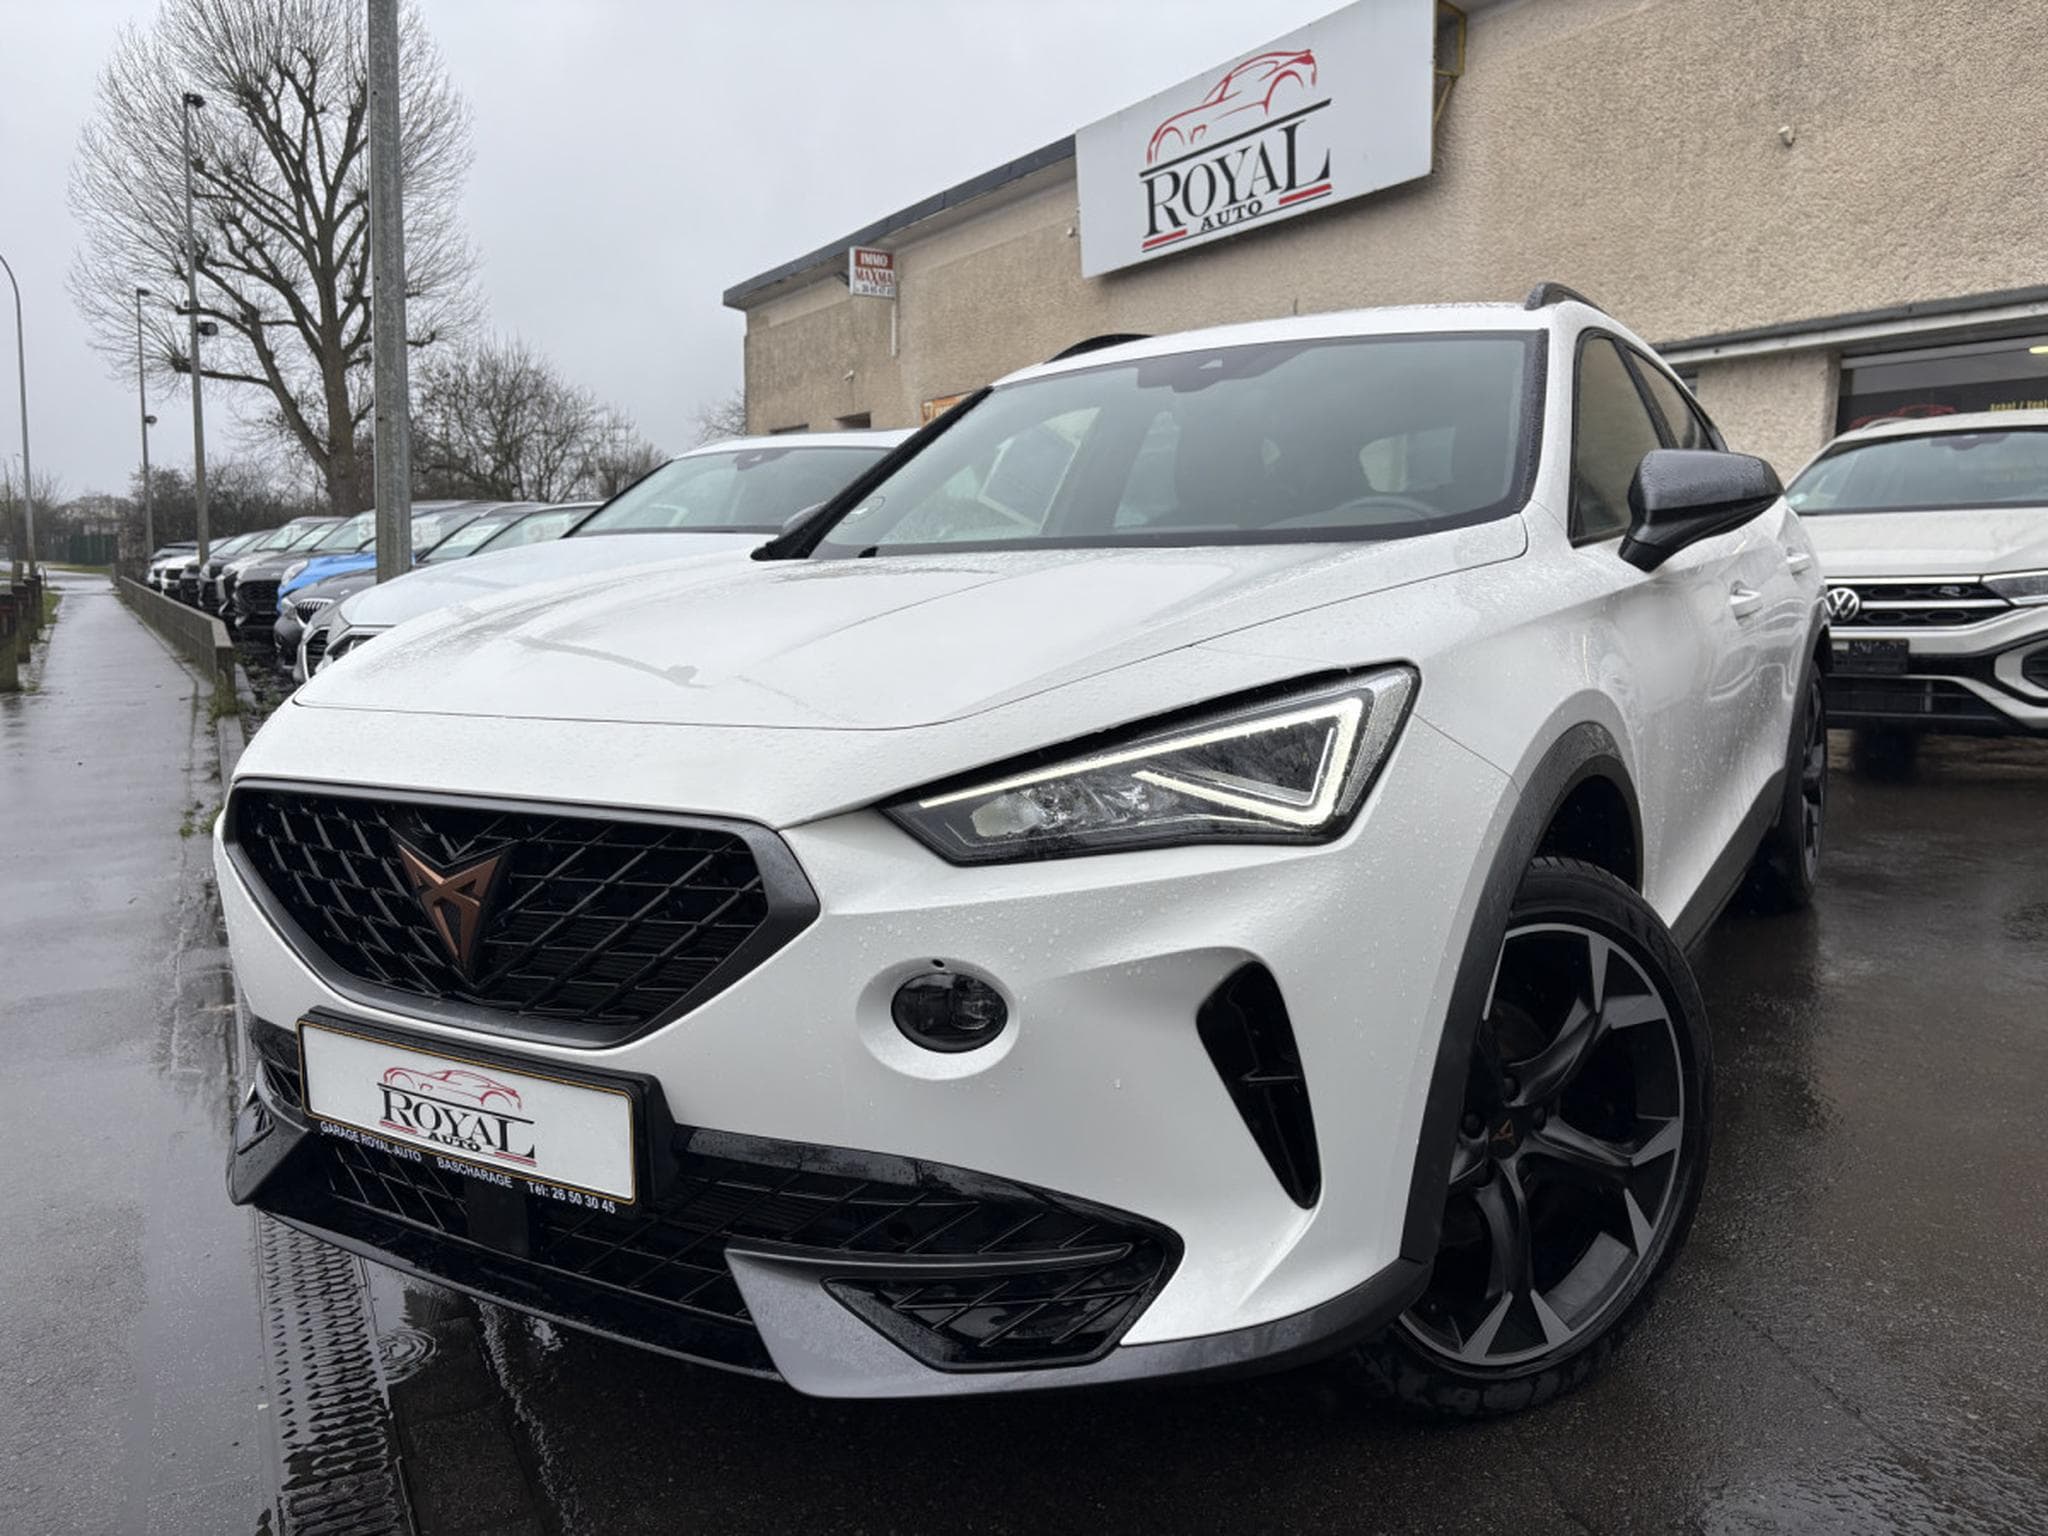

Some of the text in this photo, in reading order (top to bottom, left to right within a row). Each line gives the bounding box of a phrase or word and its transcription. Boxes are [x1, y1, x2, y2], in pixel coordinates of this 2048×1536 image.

[1143, 118, 1331, 239] ROYAL
[1200, 199, 1263, 232] AUTO
[382, 1088, 537, 1159] ROYAL
[428, 1131, 481, 1152] AUTO
[320, 1120, 360, 1142] GARAGE
[436, 1156, 513, 1189] BASCHARAGE
[567, 1192, 583, 1206] 50
[584, 1197, 600, 1210] 30
[601, 1201, 617, 1214] 45
